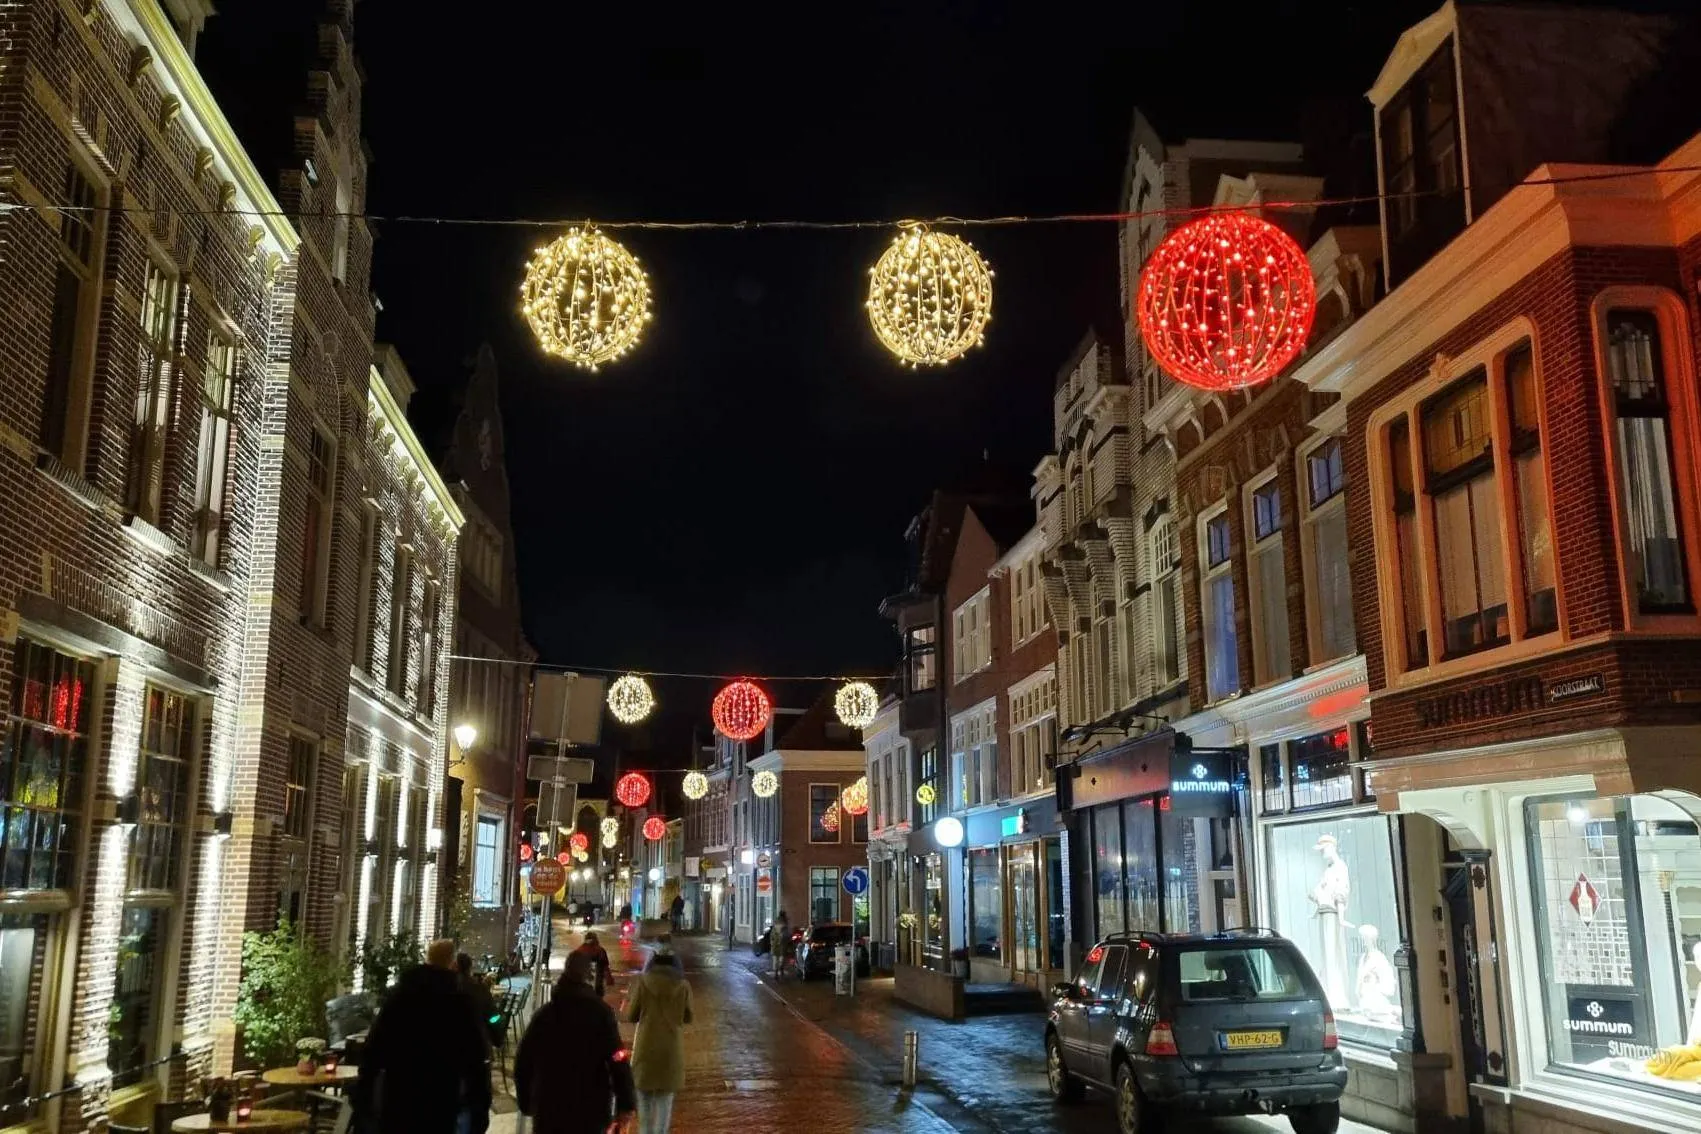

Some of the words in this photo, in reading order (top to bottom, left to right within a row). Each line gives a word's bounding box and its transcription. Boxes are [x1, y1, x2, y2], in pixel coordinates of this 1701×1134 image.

[1172, 781, 1230, 791] summum
[1563, 1019, 1632, 1034] summum
[1229, 1033, 1279, 1045] VHP-62-G
